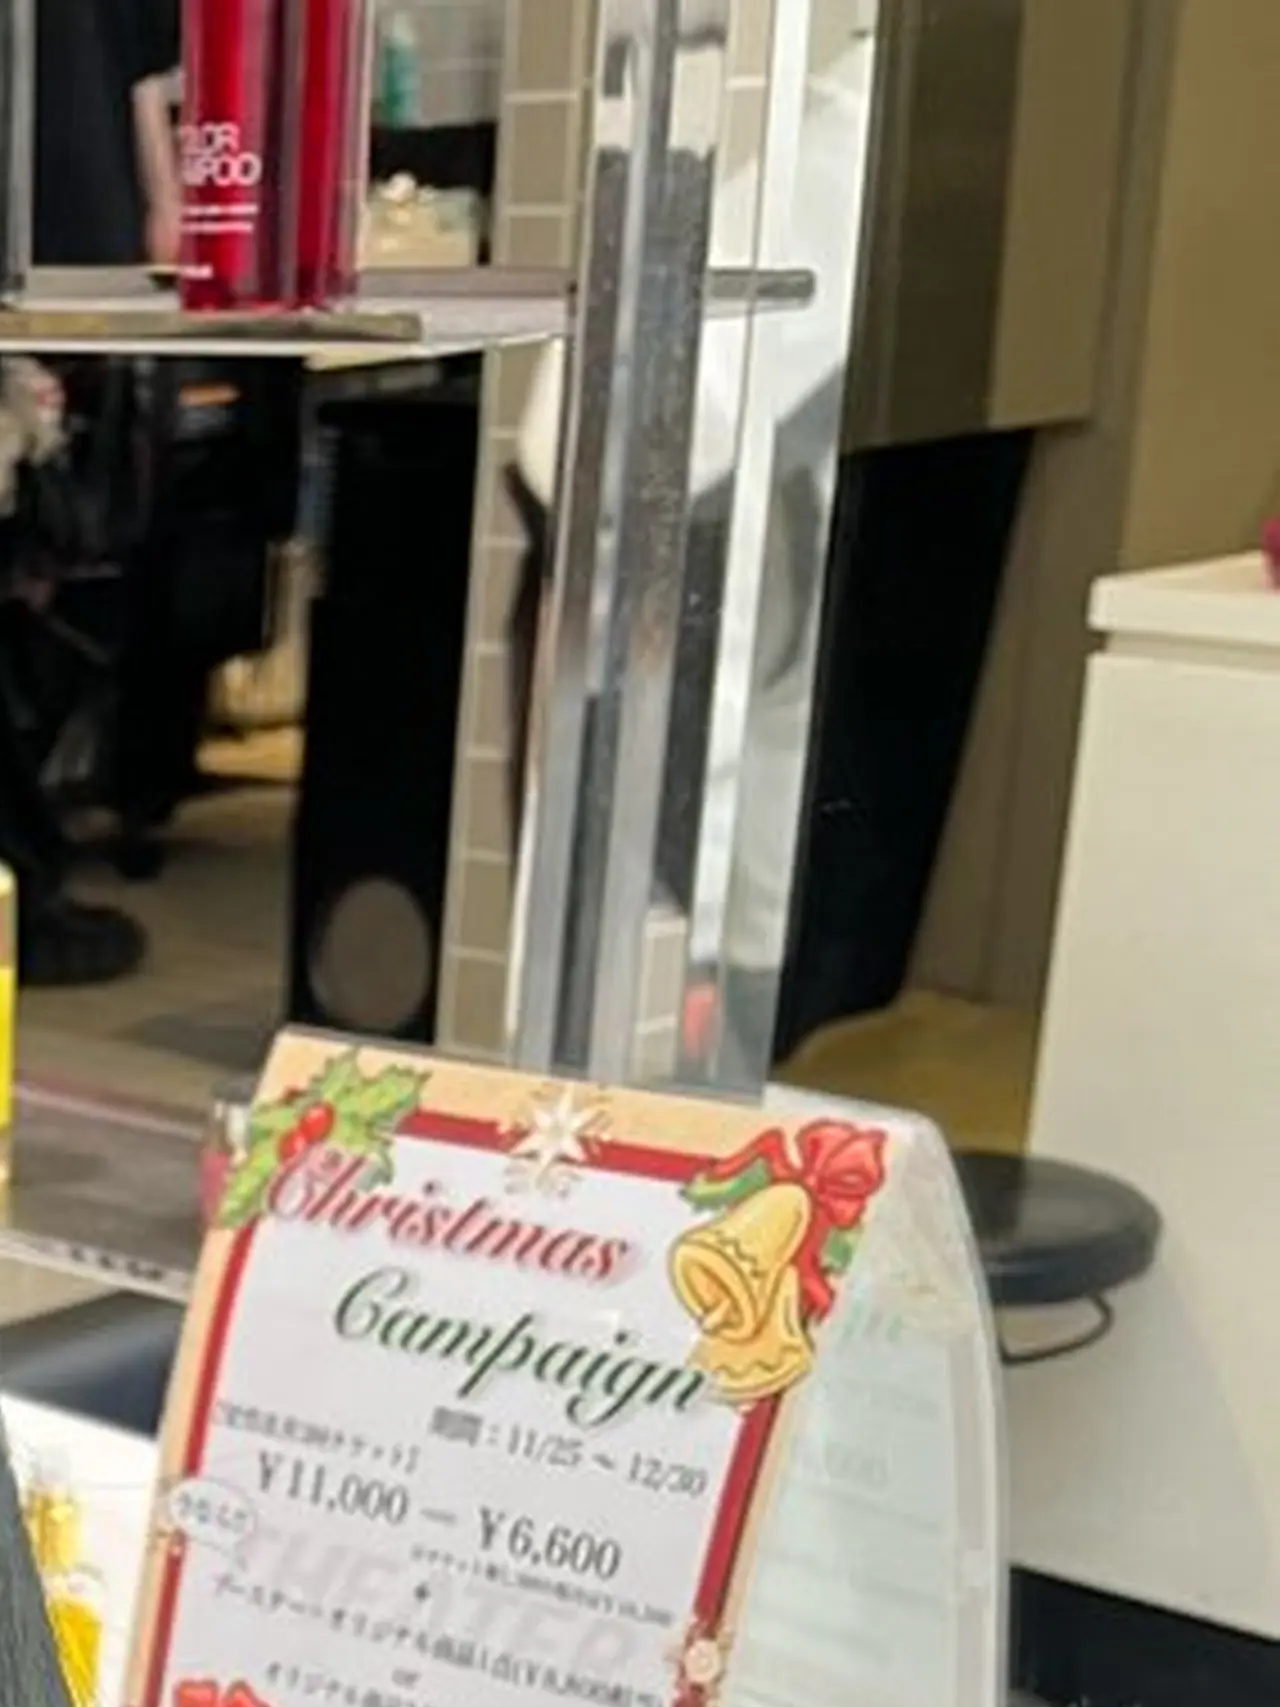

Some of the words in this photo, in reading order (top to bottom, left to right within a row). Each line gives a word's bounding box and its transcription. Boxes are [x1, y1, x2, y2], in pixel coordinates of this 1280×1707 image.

[268, 1147, 630, 1280] Christmas
[335, 1266, 704, 1427] Campaign
[257, 1448, 411, 1527] ¥11,000
[477, 1503, 623, 1581] ¥6,600
[627, 1450, 710, 1499] 12/30
